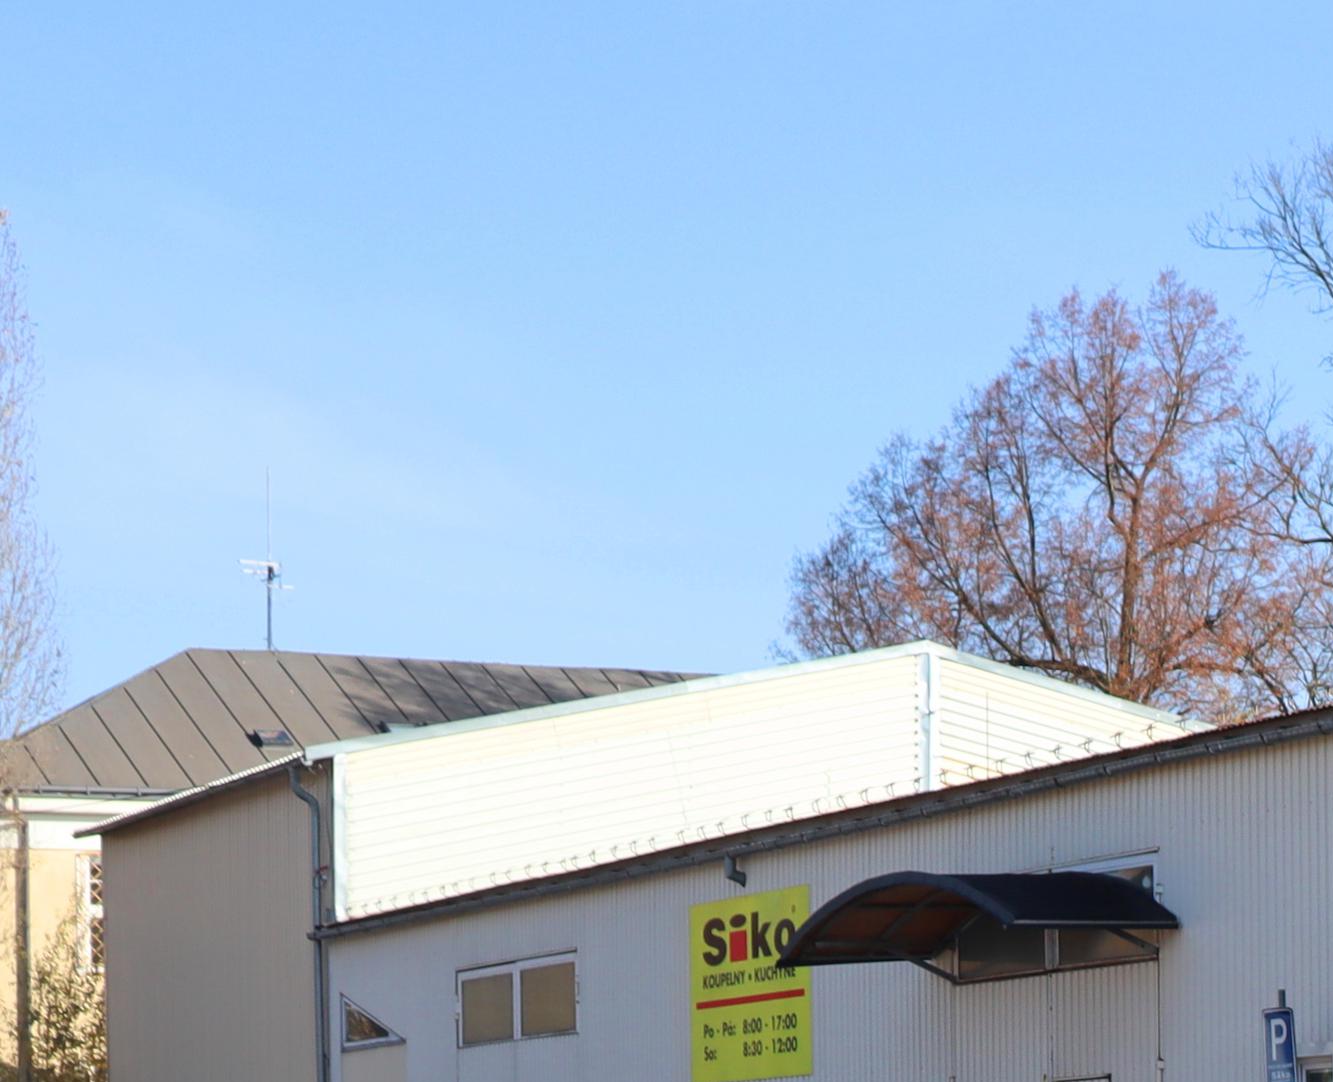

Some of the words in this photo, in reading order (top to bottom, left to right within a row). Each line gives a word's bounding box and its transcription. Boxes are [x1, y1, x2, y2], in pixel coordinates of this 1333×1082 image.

[703, 970, 745, 989] KOUPELNY
[703, 1024, 714, 1038] Po
[743, 1017, 762, 1034] 8:00
[771, 1013, 797, 1031] 17:00
[743, 1040, 762, 1057] 8:30
[772, 1036, 798, 1054] 12:00
[1270, 1018, 1287, 1061] P
